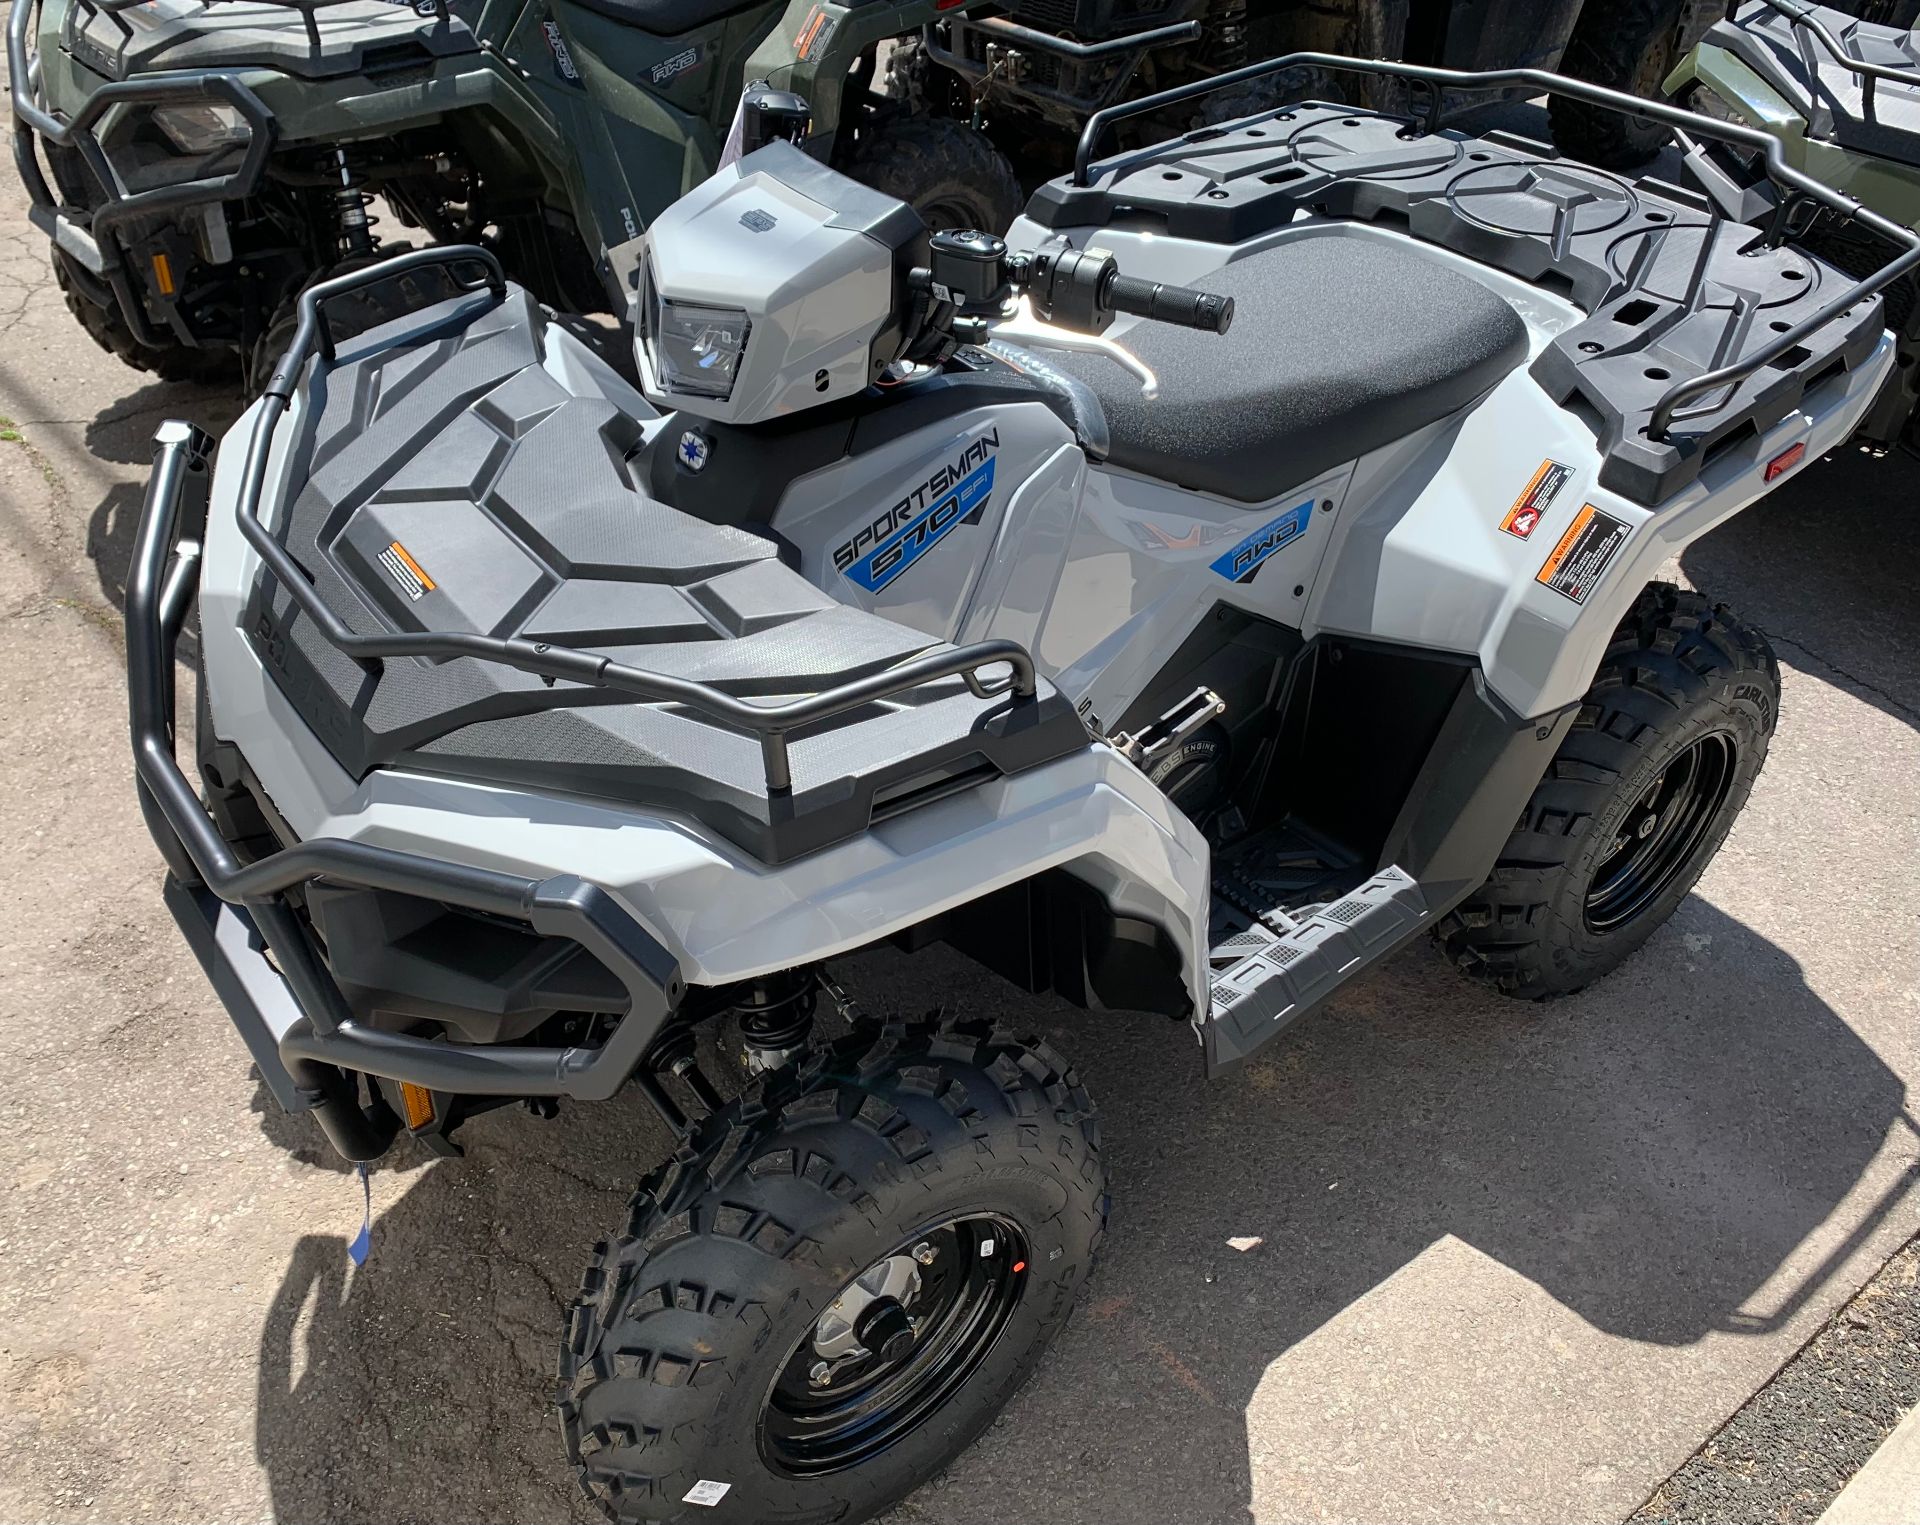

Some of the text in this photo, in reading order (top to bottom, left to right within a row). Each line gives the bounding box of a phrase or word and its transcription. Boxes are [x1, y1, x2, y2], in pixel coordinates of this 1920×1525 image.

[653, 52, 697, 83] AWD
[832, 427, 1000, 574] SPORTSMAN
[870, 472, 988, 581] 570 EFI
[1233, 519, 1299, 575] AWD
[1556, 523, 1581, 556] WARNING
[1183, 742, 1216, 755] ENGINE
